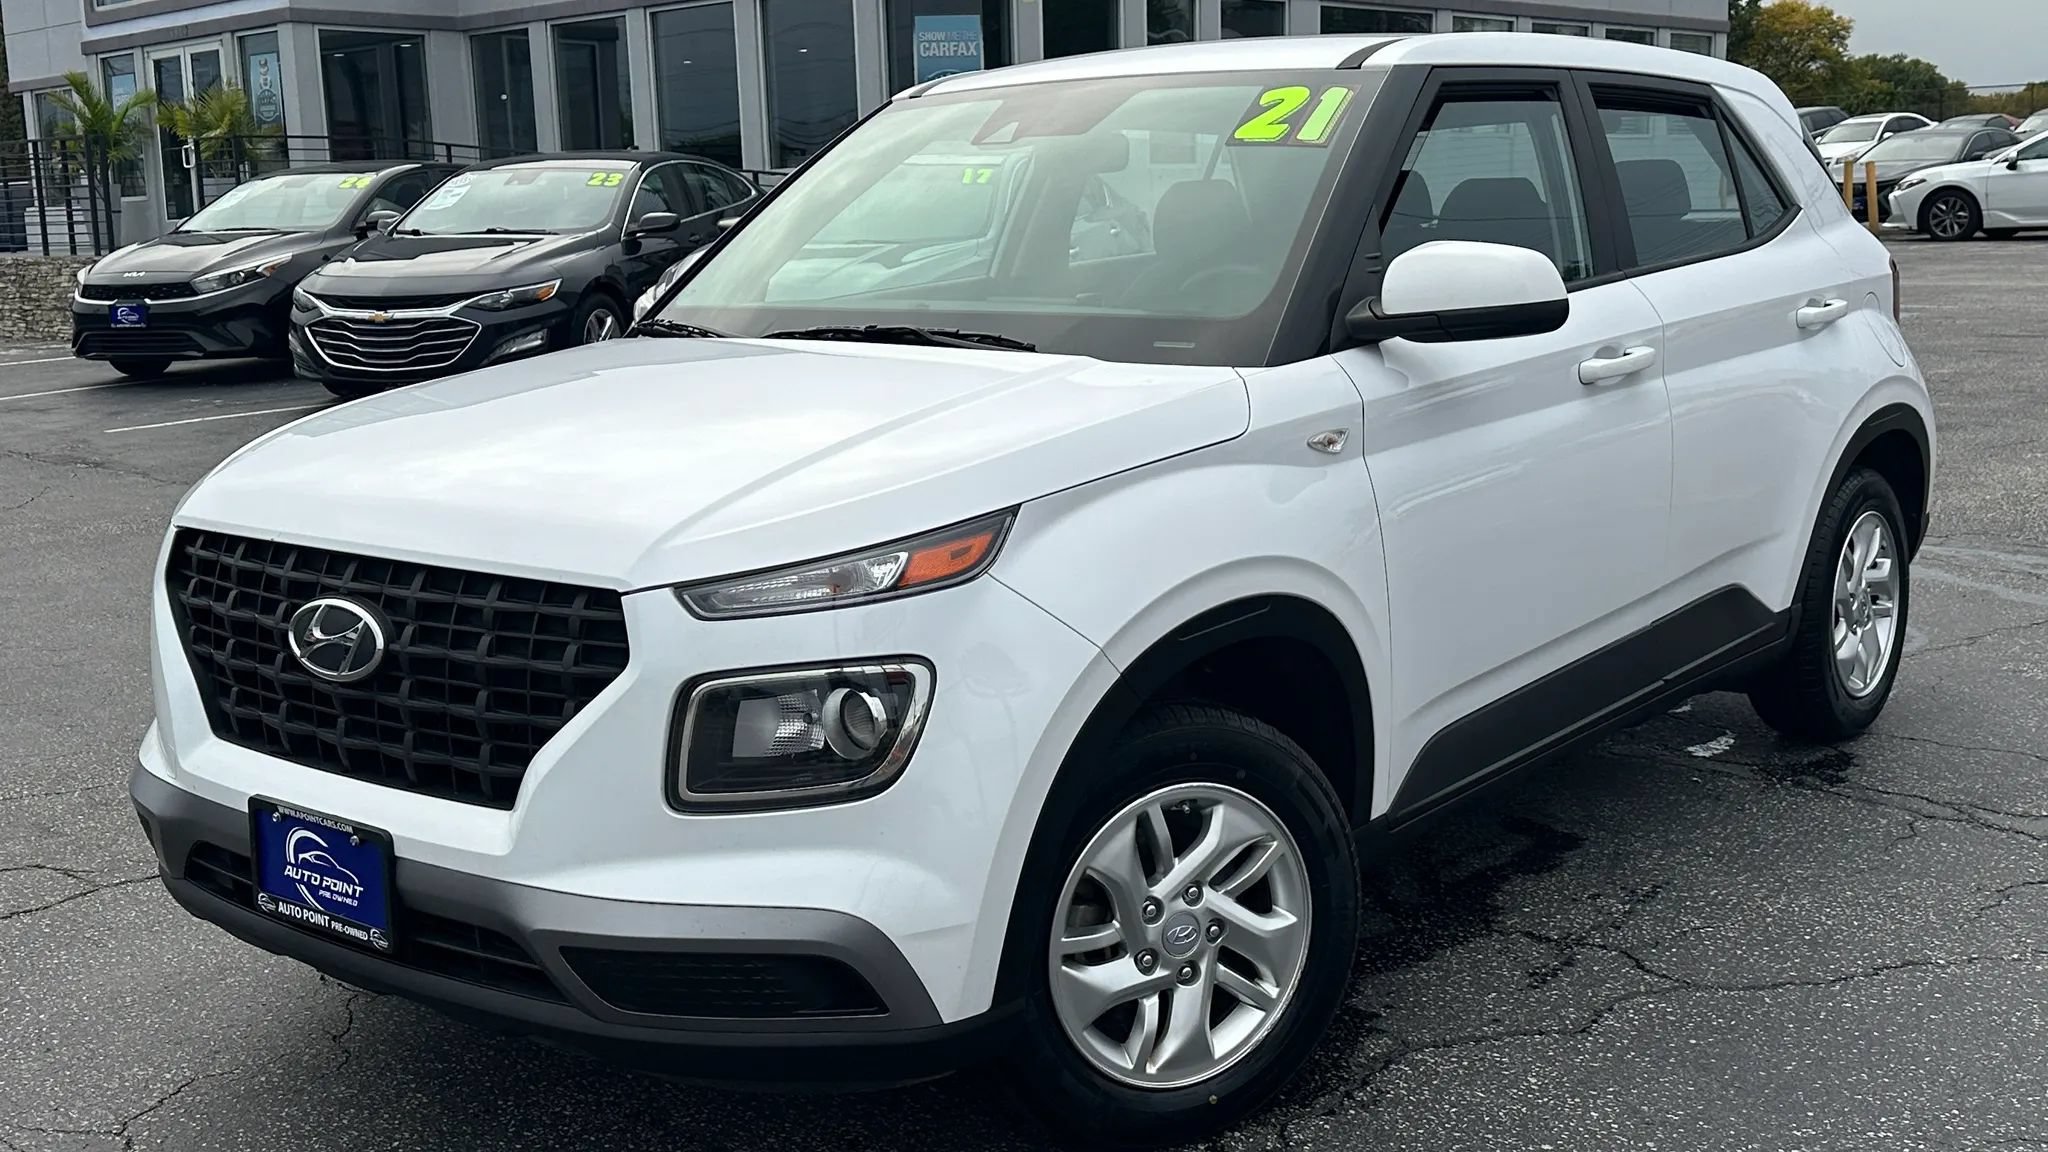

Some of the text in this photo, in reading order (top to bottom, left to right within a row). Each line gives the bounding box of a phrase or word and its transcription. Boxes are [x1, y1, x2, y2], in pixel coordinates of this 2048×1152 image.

[919, 31, 946, 41] SHOW
[920, 42, 977, 57] CARFAX
[1234, 86, 1353, 143] 21
[586, 171, 624, 187] 23
[962, 167, 993, 184] 17
[284, 865, 364, 898] AUTO POINT
[318, 889, 358, 907] PRE OWNED
[278, 902, 369, 941] AUTO POINT PRE-OWNED
